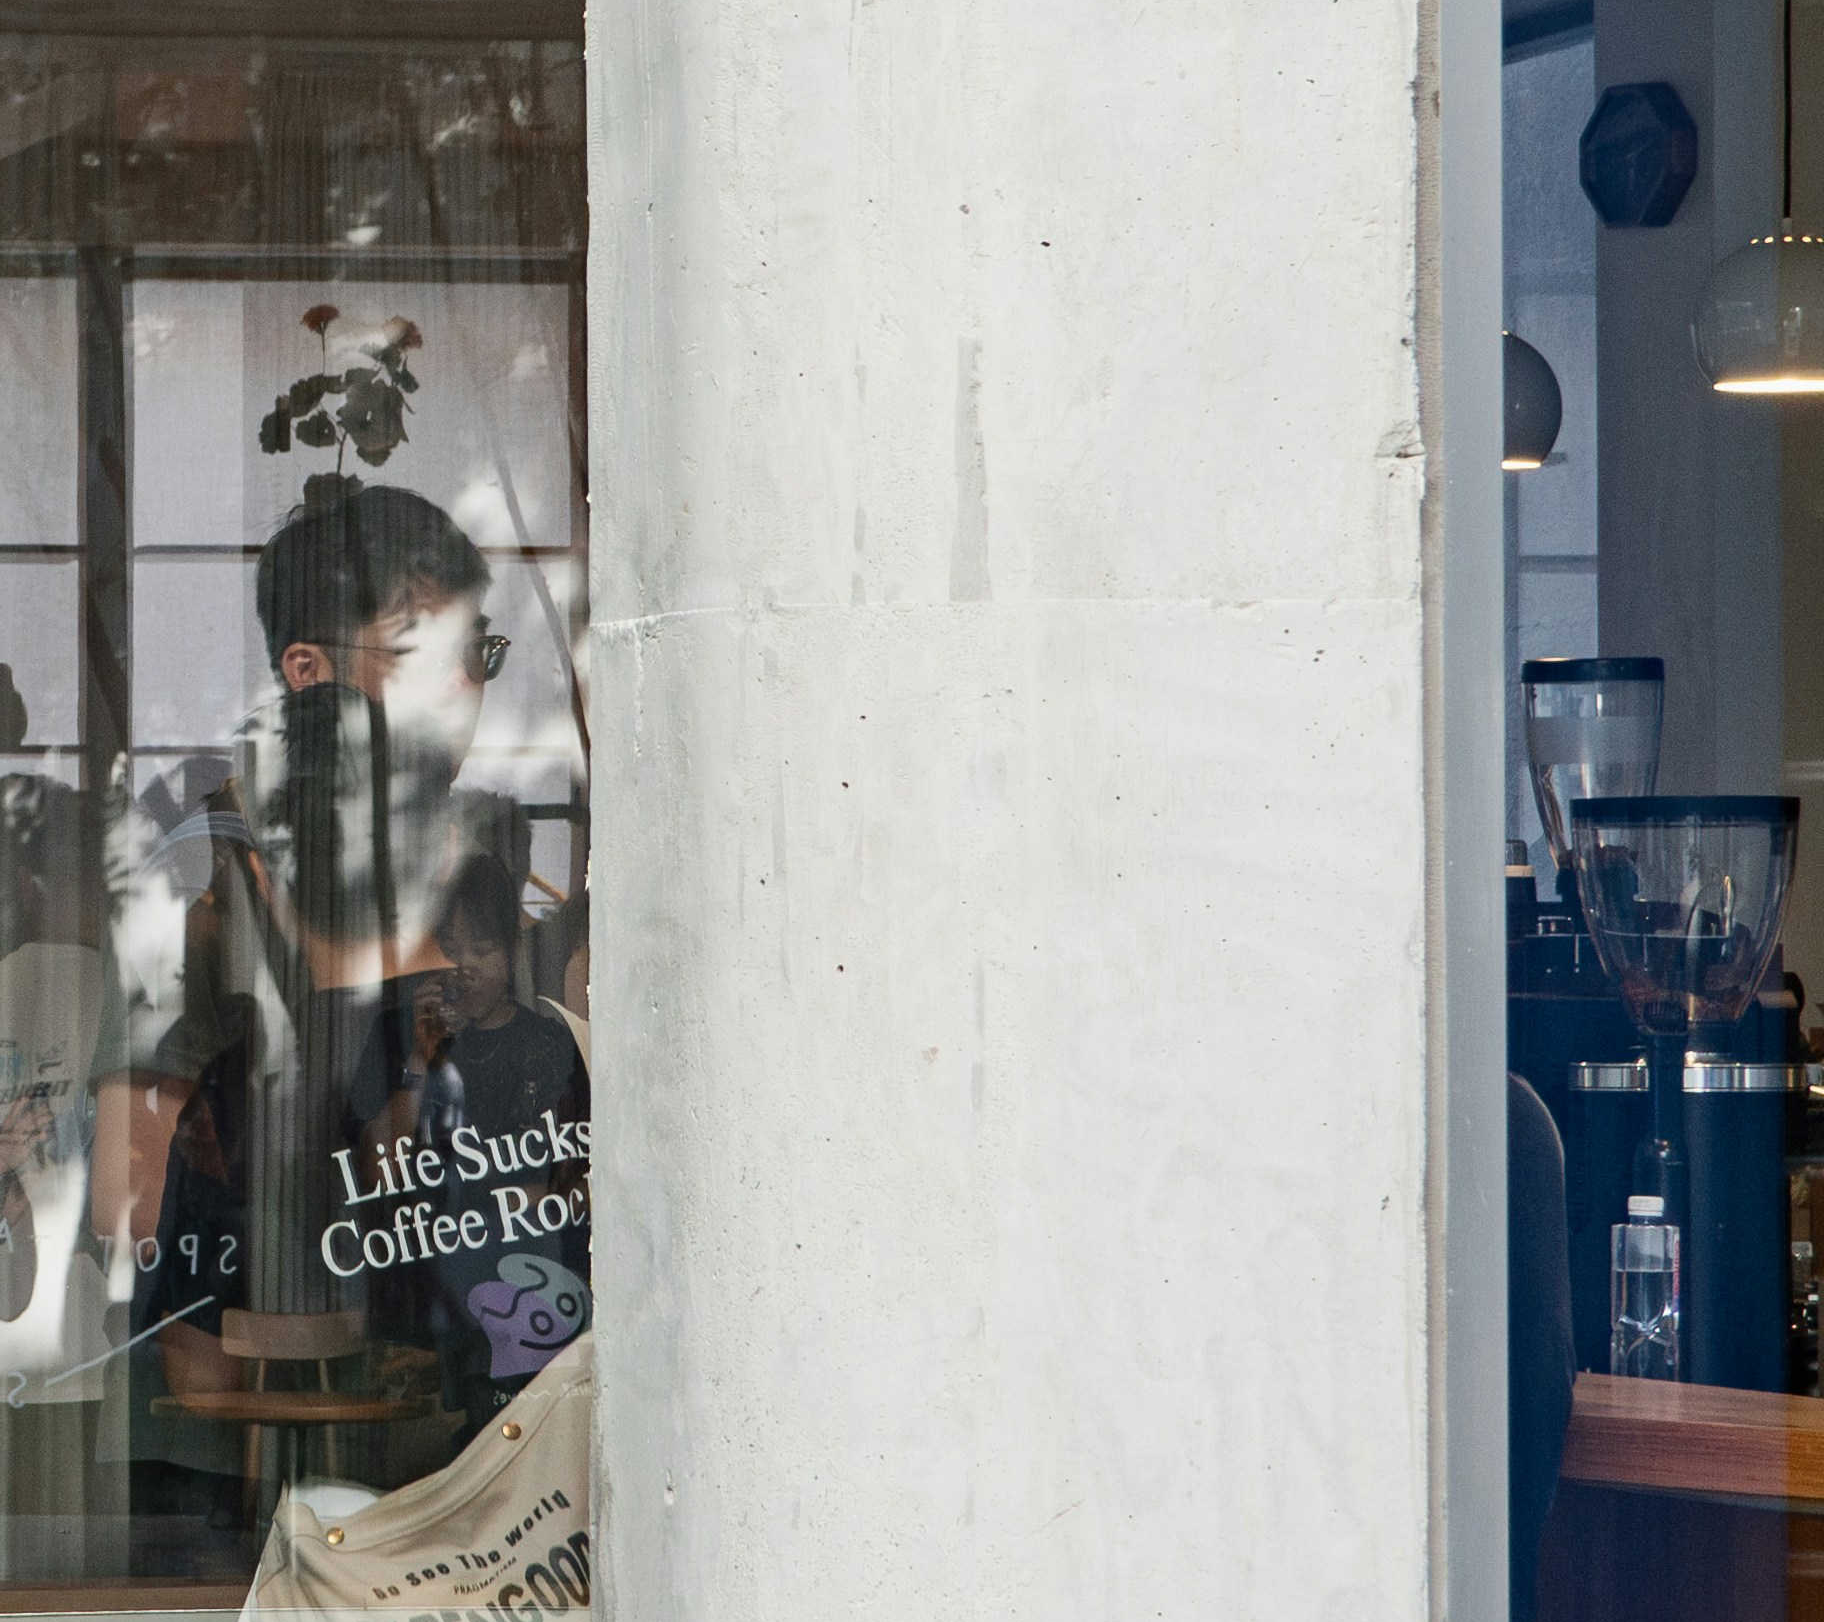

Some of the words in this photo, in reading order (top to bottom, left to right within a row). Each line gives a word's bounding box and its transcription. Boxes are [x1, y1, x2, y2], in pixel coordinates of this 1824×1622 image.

[331, 1136, 445, 1205] Life
[451, 1109, 592, 1182] Sucks
[320, 1202, 488, 1277] Coffee
[455, 1549, 502, 1571] The
[504, 1488, 572, 1548] World
